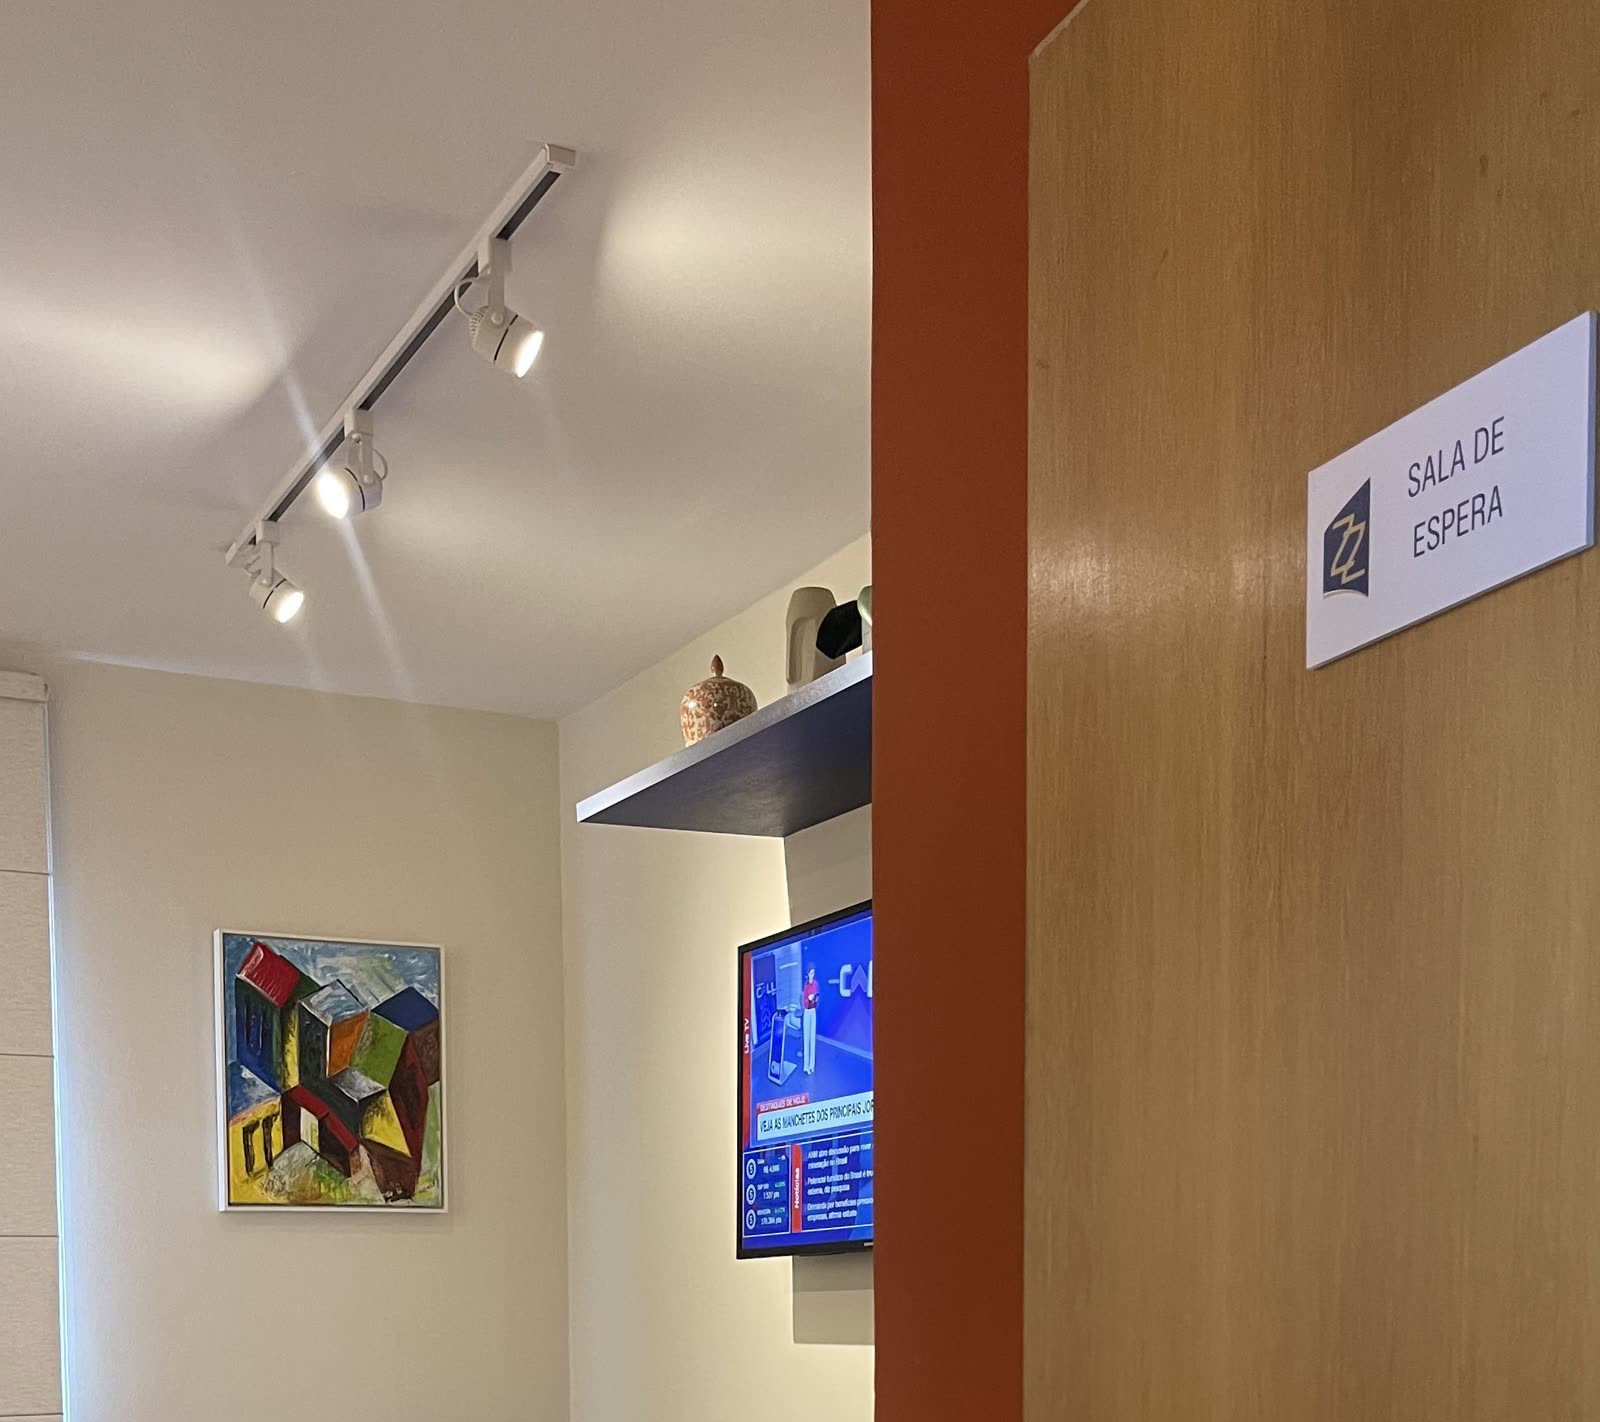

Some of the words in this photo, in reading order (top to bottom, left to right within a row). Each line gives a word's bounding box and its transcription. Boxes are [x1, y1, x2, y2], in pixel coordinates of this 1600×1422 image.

[1408, 440, 1465, 498] SALA
[1474, 416, 1505, 464] DE
[1413, 485, 1503, 558] ESPERA
[760, 1119, 773, 1133] VEJA
[774, 1117, 782, 1130] AS
[782, 1110, 815, 1128] MANCHETES
[816, 1108, 828, 1123] DOS
[829, 1101, 861, 1120] PRINCIPAIS
